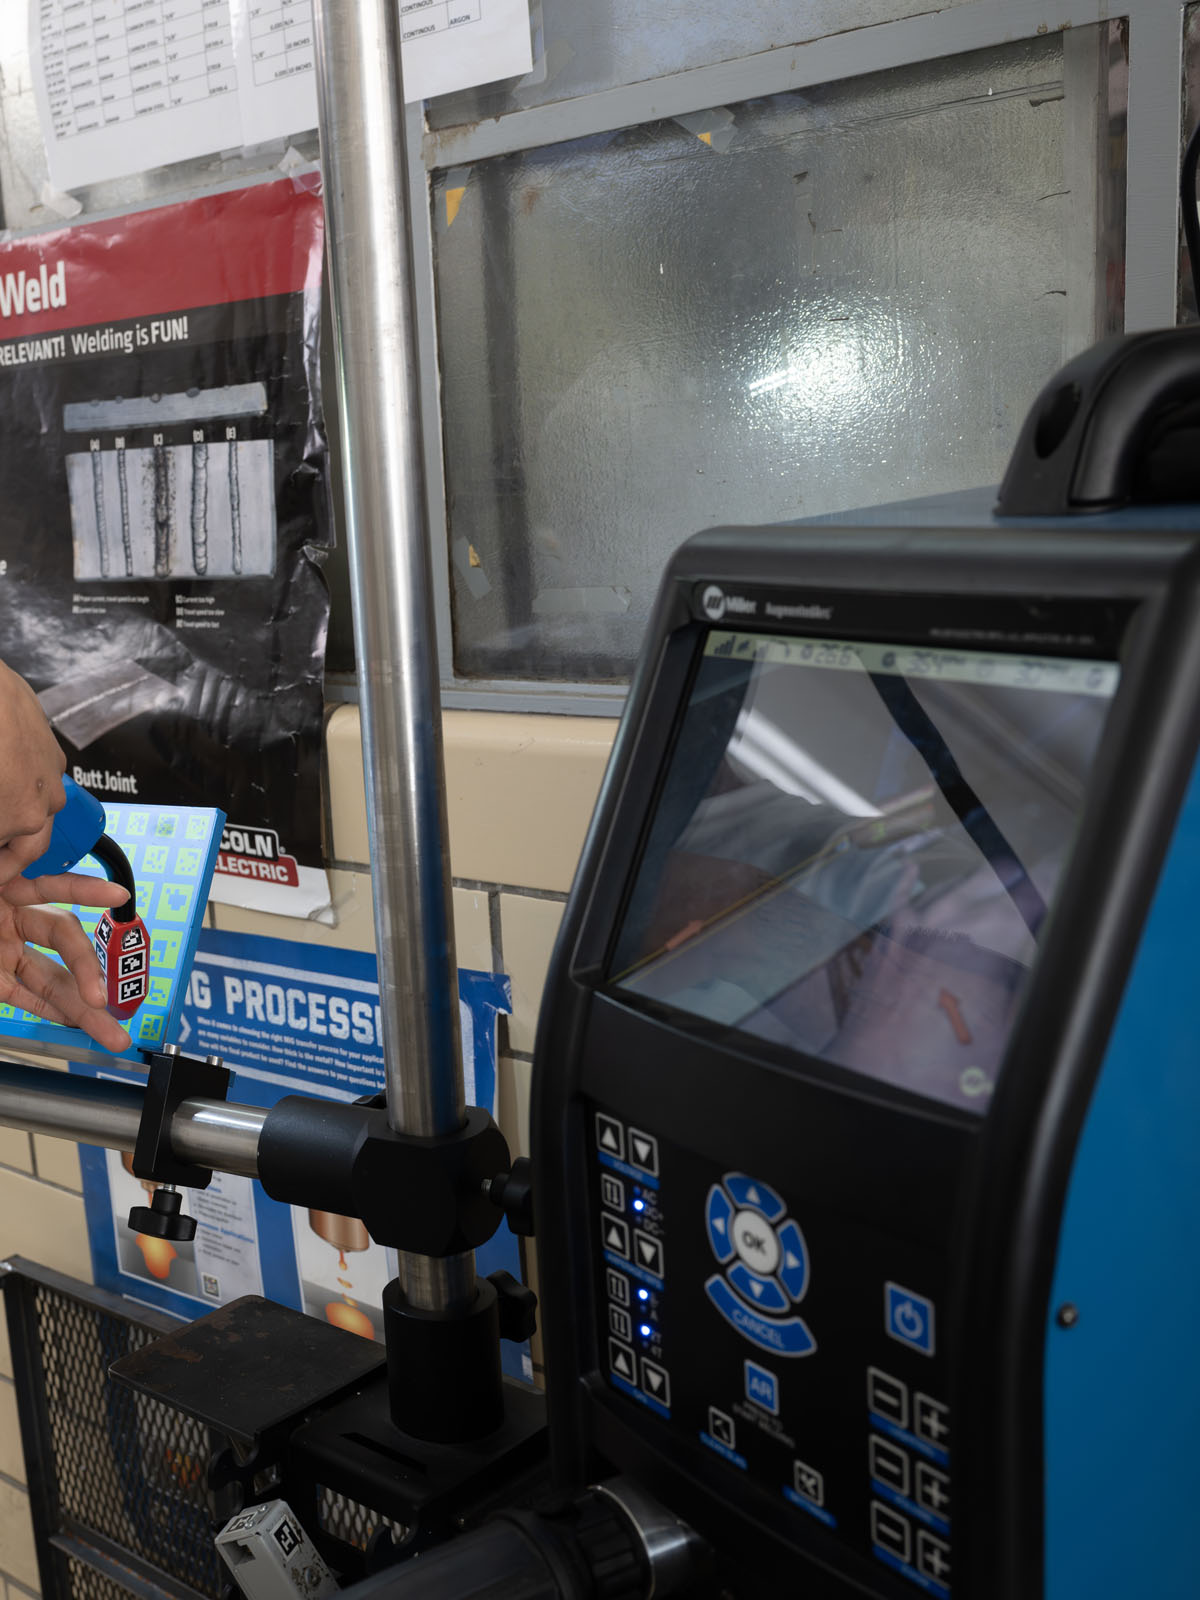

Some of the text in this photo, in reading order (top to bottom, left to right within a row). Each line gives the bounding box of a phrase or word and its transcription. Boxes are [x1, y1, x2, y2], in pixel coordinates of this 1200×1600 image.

[402, 24, 435, 39] CONTINOUS
[450, 14, 471, 26] ARGON
[70, 329, 134, 356] Welding
[136, 325, 149, 346] is
[150, 316, 189, 343] FUN!
[73, 766, 138, 794] Butt Joint
[742, 1231, 766, 1254] OK
[731, 1308, 785, 1350] CANCEL
